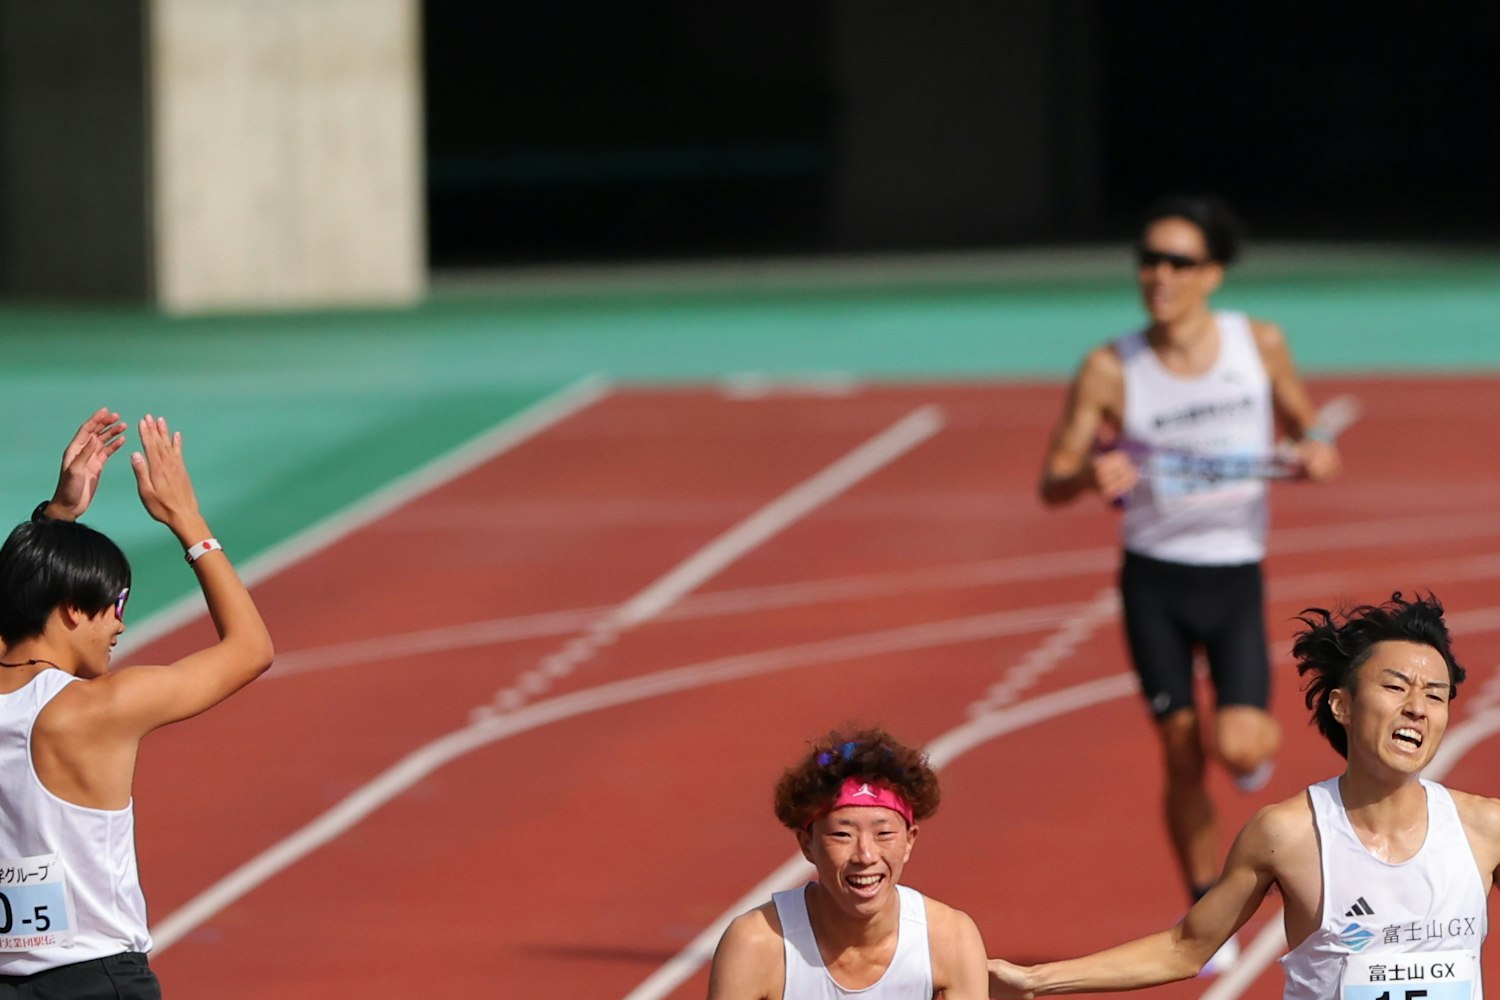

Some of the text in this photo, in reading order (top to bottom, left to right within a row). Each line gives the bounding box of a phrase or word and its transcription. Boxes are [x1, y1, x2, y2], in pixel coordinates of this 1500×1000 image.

[1368, 963, 1456, 982] 富士山 GX
